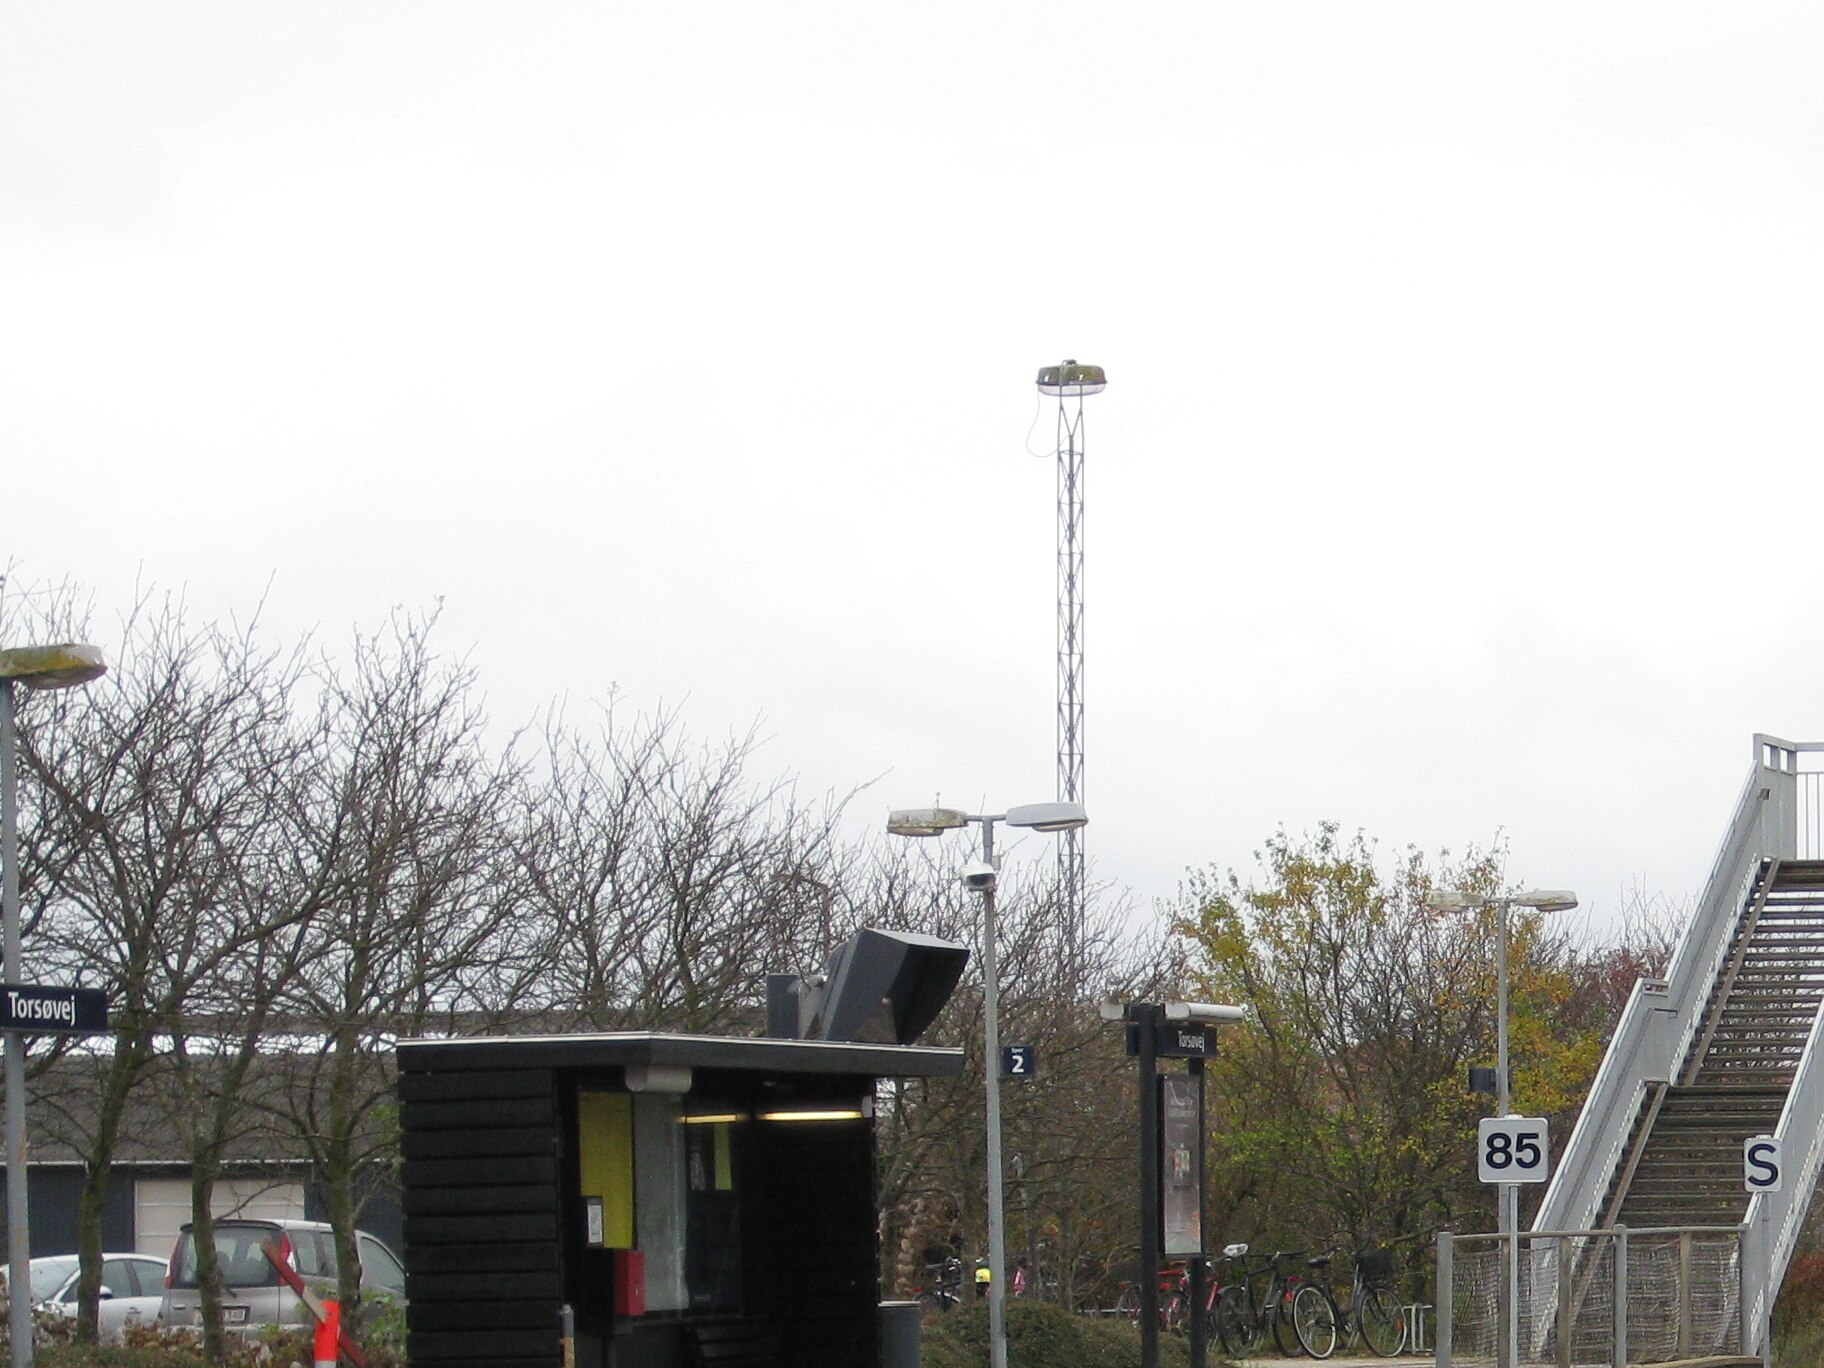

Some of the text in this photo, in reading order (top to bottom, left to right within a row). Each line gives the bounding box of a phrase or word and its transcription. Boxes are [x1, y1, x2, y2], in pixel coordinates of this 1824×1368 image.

[7, 991, 76, 1027] Torsøvej
[1011, 1055, 1025, 1073] 2
[1485, 1132, 1541, 1169] 85
[1747, 1143, 1779, 1187] S
